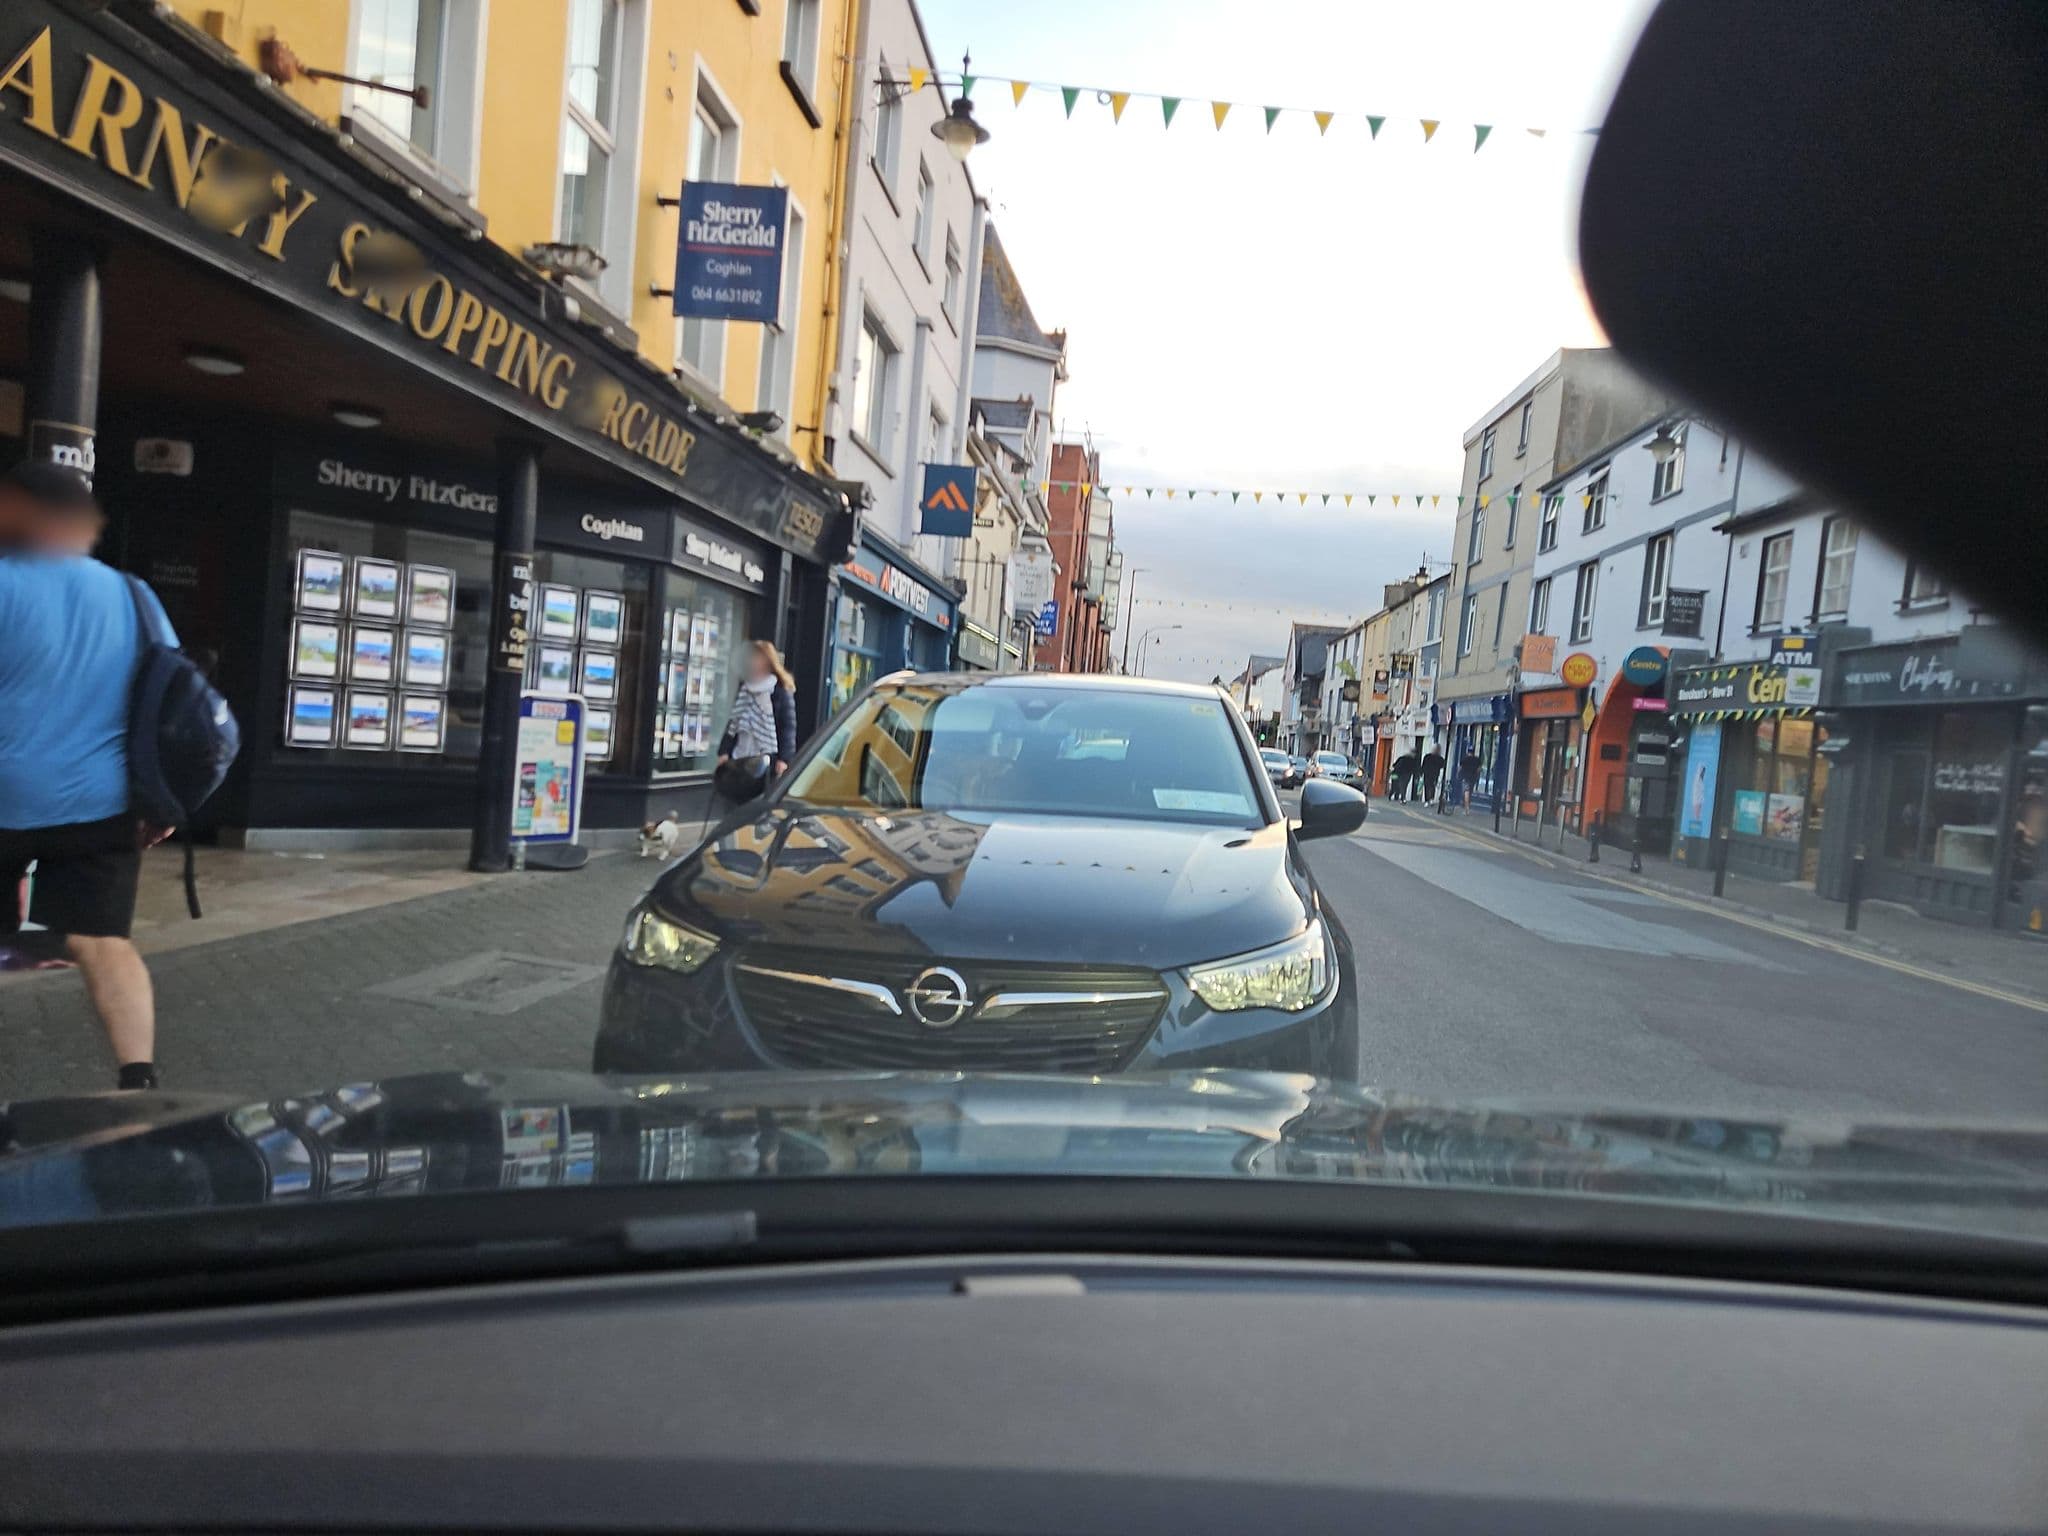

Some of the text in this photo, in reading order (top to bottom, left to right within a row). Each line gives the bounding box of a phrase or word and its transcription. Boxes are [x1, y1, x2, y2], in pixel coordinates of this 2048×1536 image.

[702, 200, 762, 227] Sherry
[686, 220, 776, 248] FitzGerald
[0, 24, 318, 262] ARNY
[578, 380, 696, 478] RCADE
[705, 259, 752, 279] Coghlan
[691, 286, 713, 301] 064
[317, 459, 402, 502] Sherry
[581, 514, 644, 543] Coghlan
[1772, 651, 1813, 665] ATM
